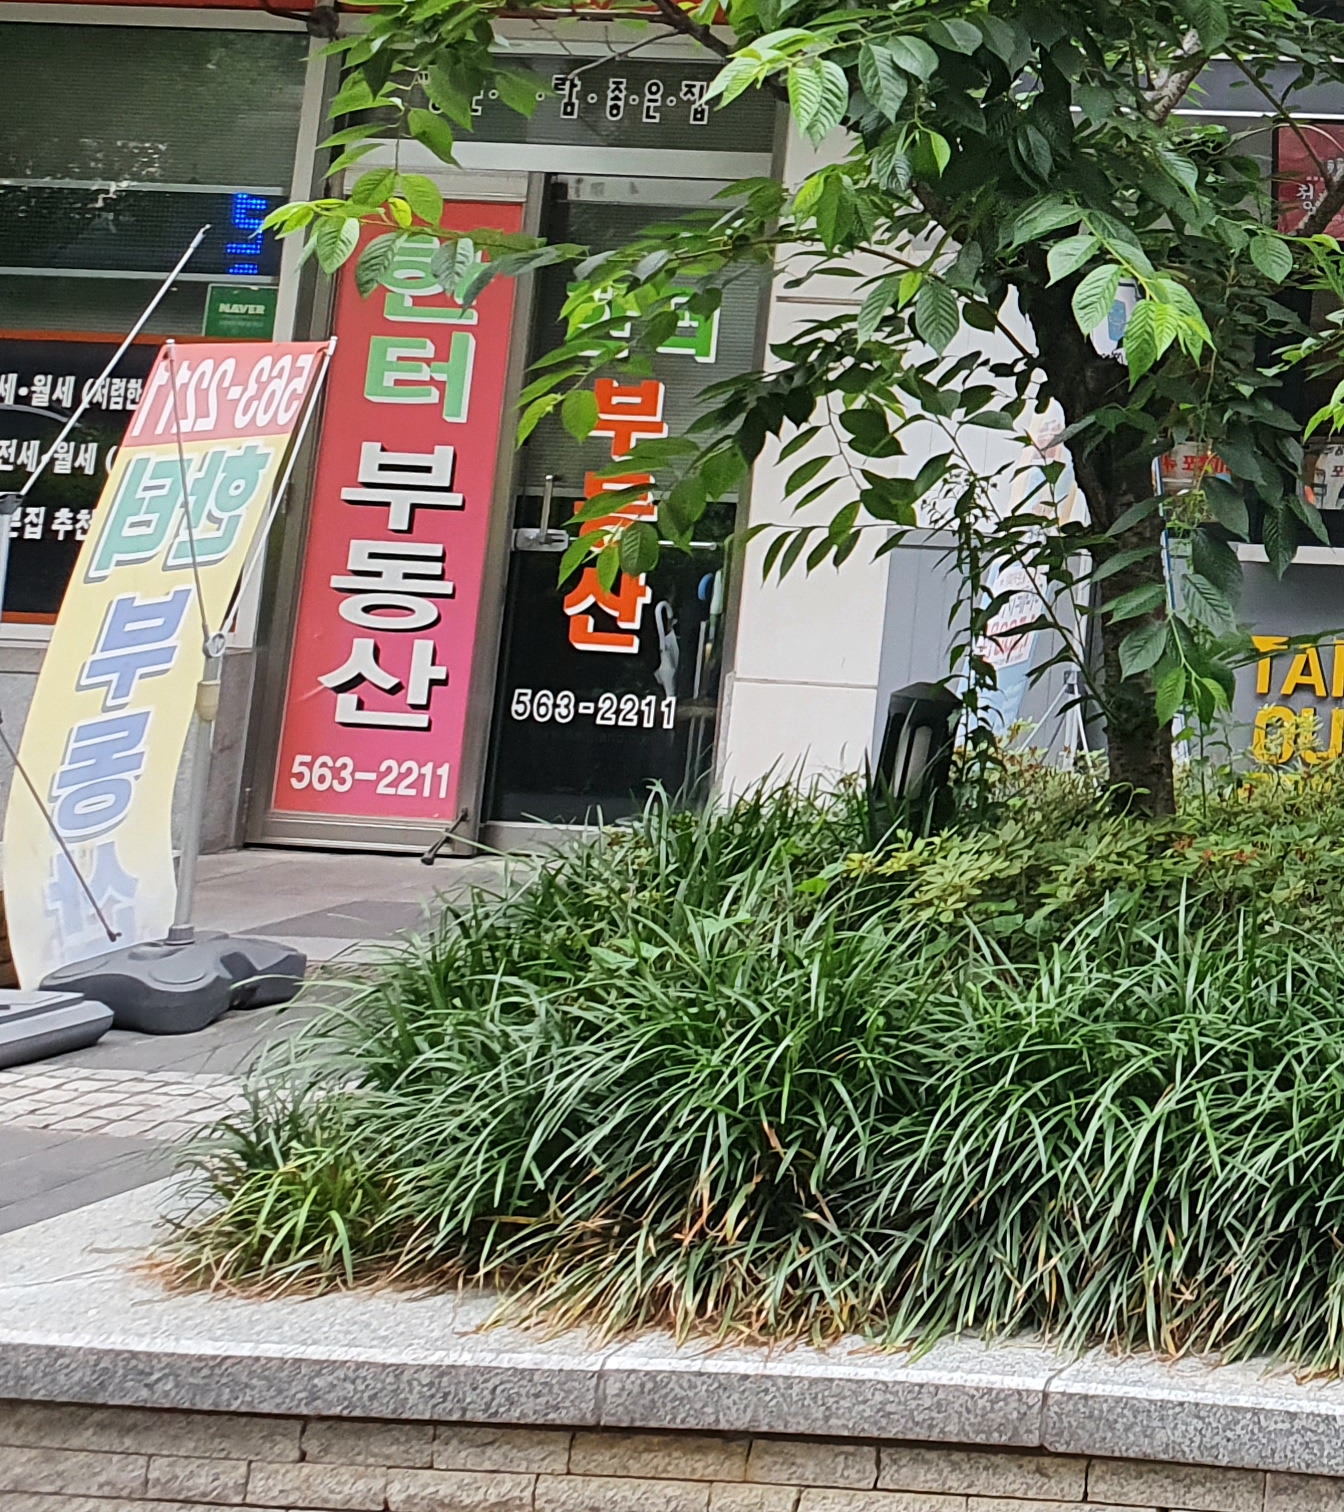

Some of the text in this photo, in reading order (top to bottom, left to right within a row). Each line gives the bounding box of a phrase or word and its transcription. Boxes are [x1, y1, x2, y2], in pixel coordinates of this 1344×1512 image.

[218, 303, 266, 315] NAVER
[316, 441, 464, 730] 부동산
[510, 689, 677, 730] 563-2211
[290, 754, 451, 800] 563-2211
